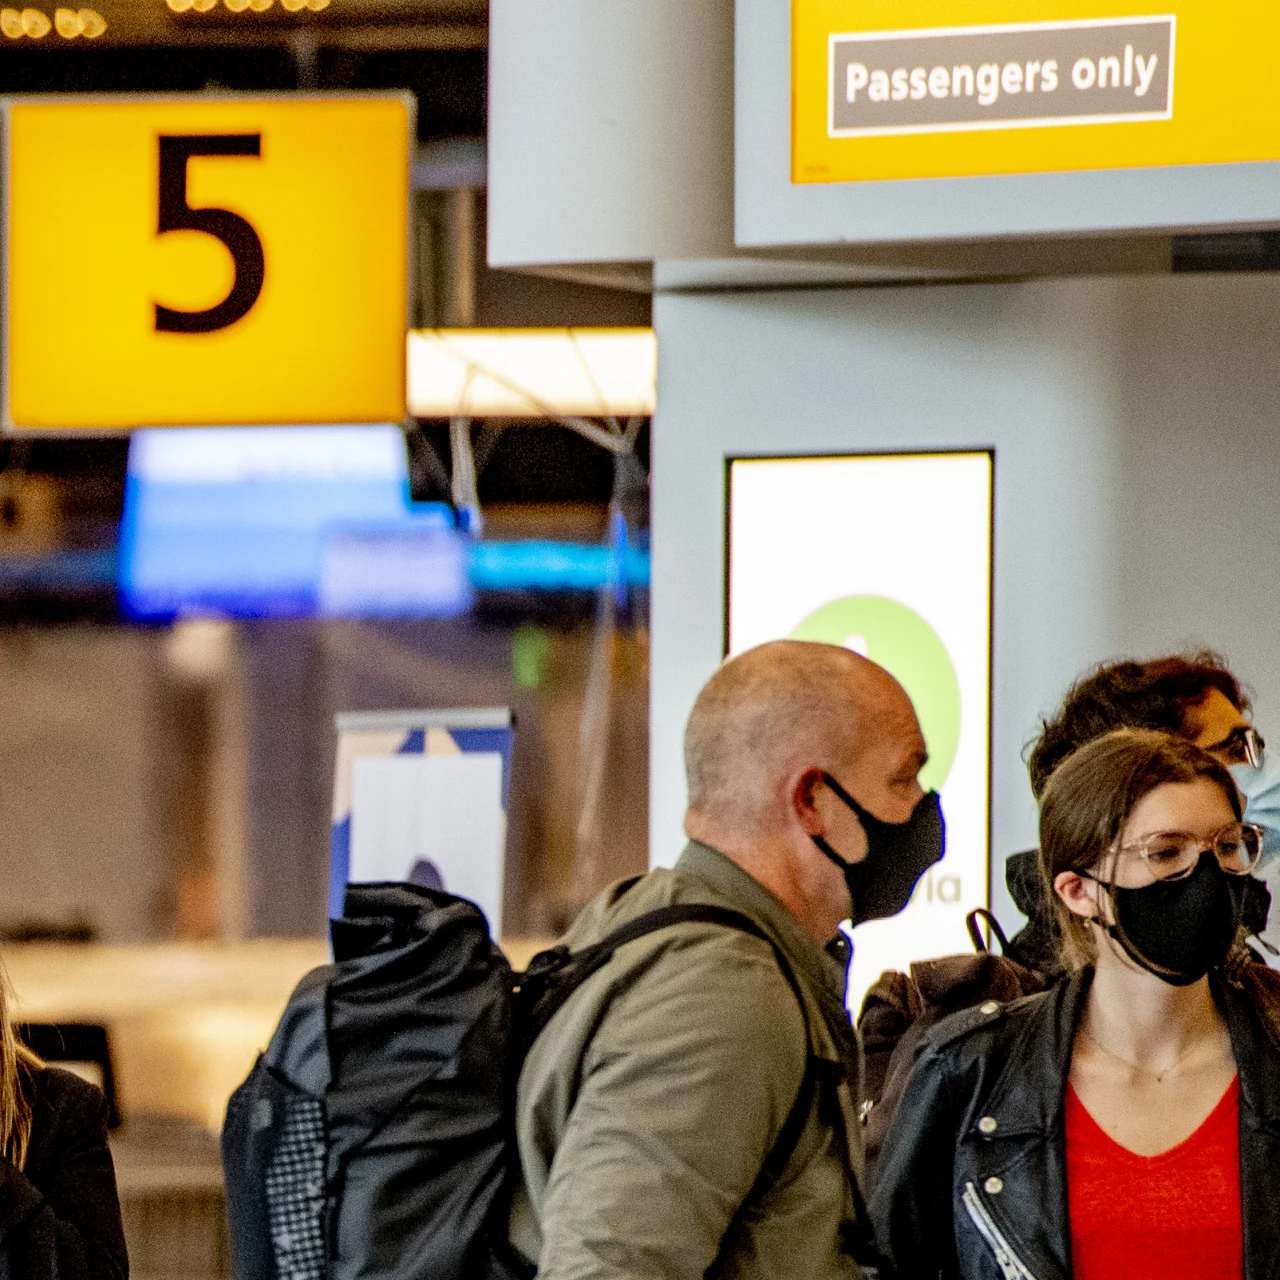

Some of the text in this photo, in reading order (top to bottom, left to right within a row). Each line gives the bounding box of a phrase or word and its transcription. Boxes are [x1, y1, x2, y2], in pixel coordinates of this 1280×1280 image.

[846, 44, 1159, 106] Passengers only
[154, 133, 266, 334] 5
